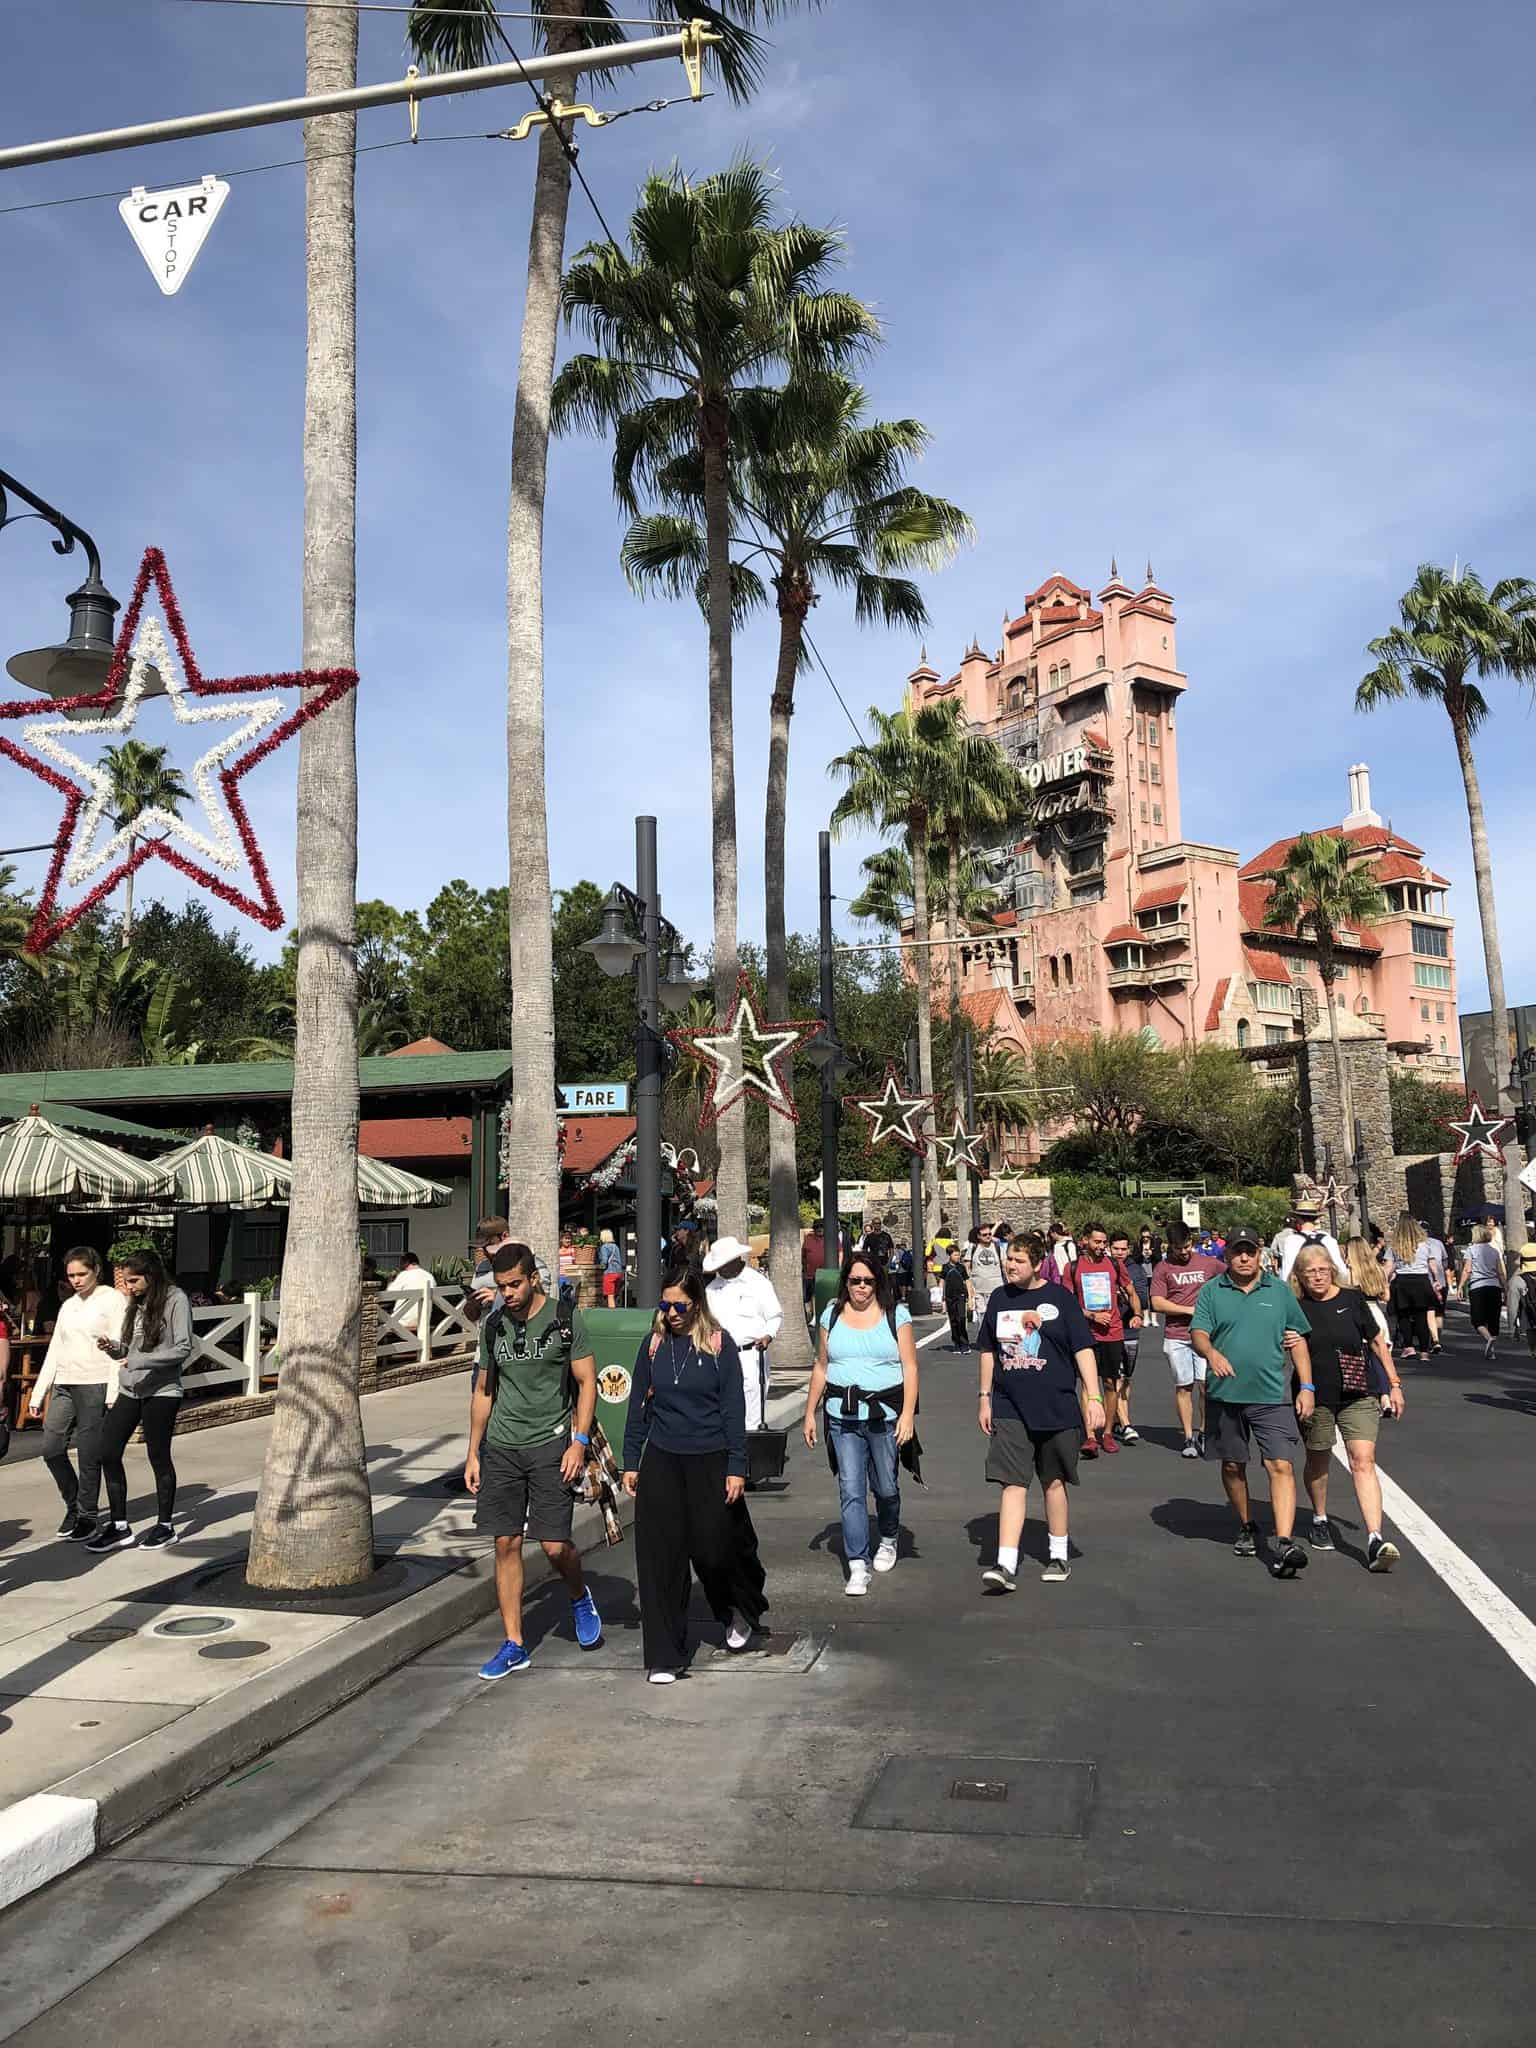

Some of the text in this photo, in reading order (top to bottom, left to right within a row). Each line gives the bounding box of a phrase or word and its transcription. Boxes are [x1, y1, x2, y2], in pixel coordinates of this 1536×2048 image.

[139, 196, 208, 223] CAR
[165, 219, 177, 279] STOP
[575, 1090, 616, 1106] FARE
[1171, 1270, 1205, 1285] VANS
